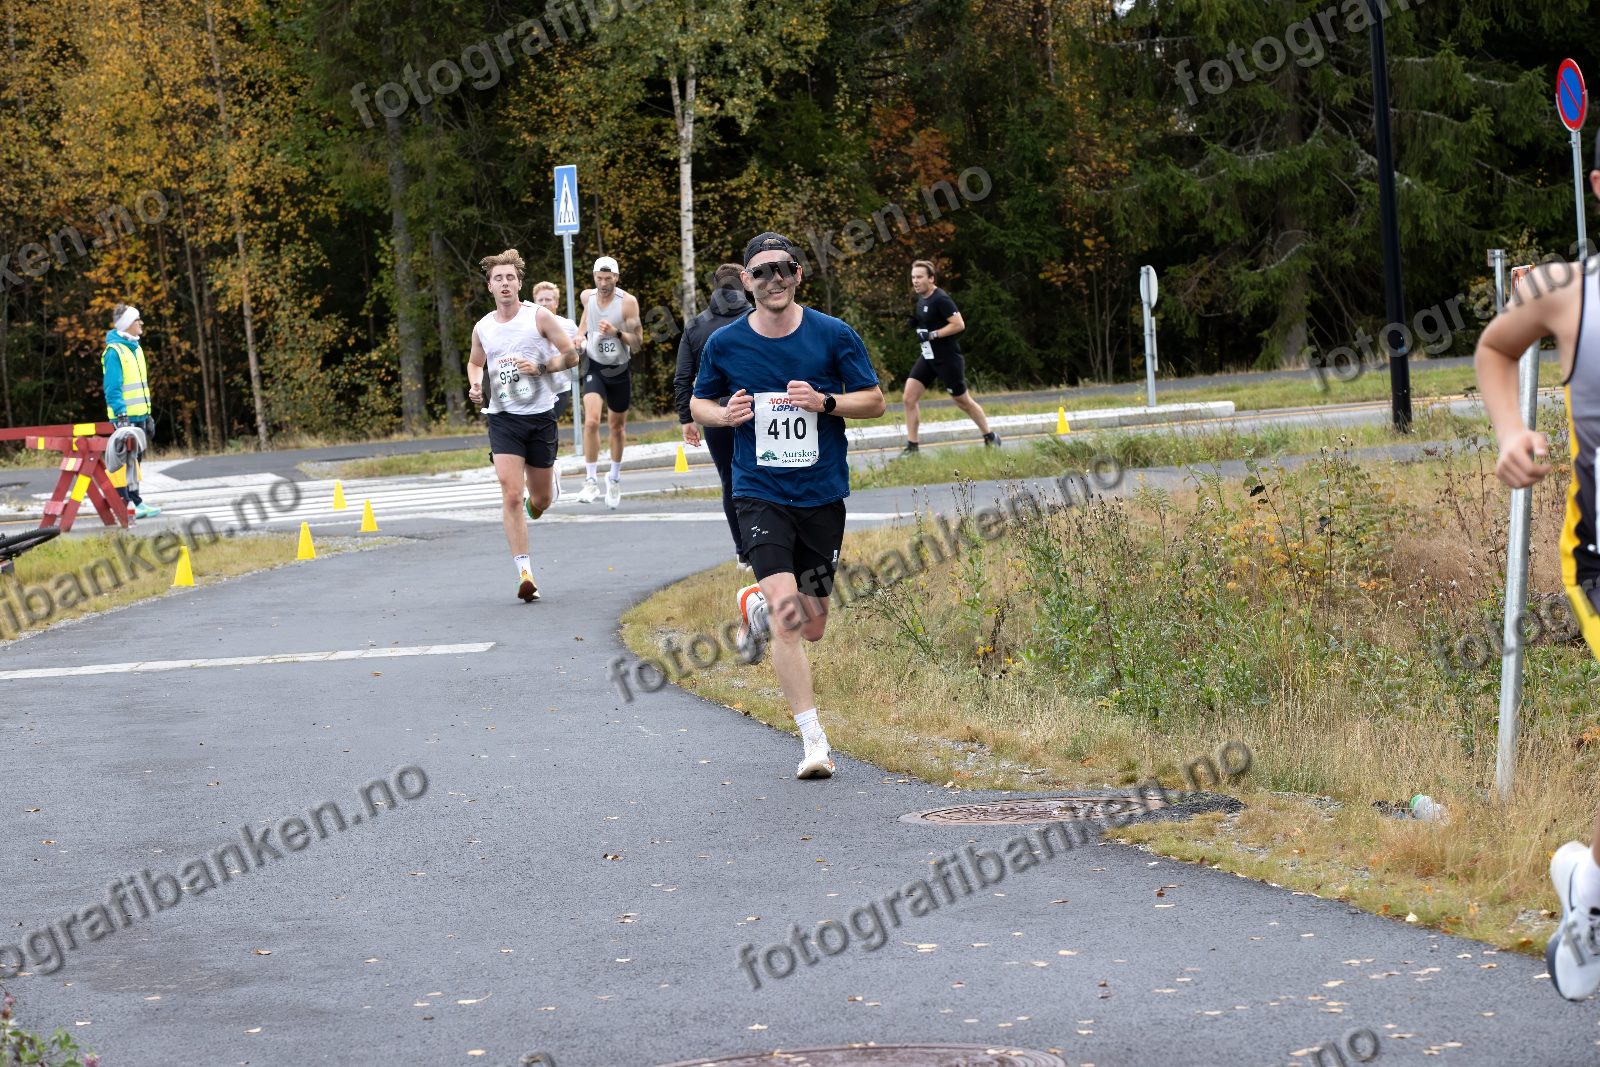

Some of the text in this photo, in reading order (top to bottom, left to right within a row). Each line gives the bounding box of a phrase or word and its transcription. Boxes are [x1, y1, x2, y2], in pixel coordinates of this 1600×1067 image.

[598, 342, 616, 353] 382
[767, 416, 807, 440] 410
[782, 449, 817, 459] Aurskog
